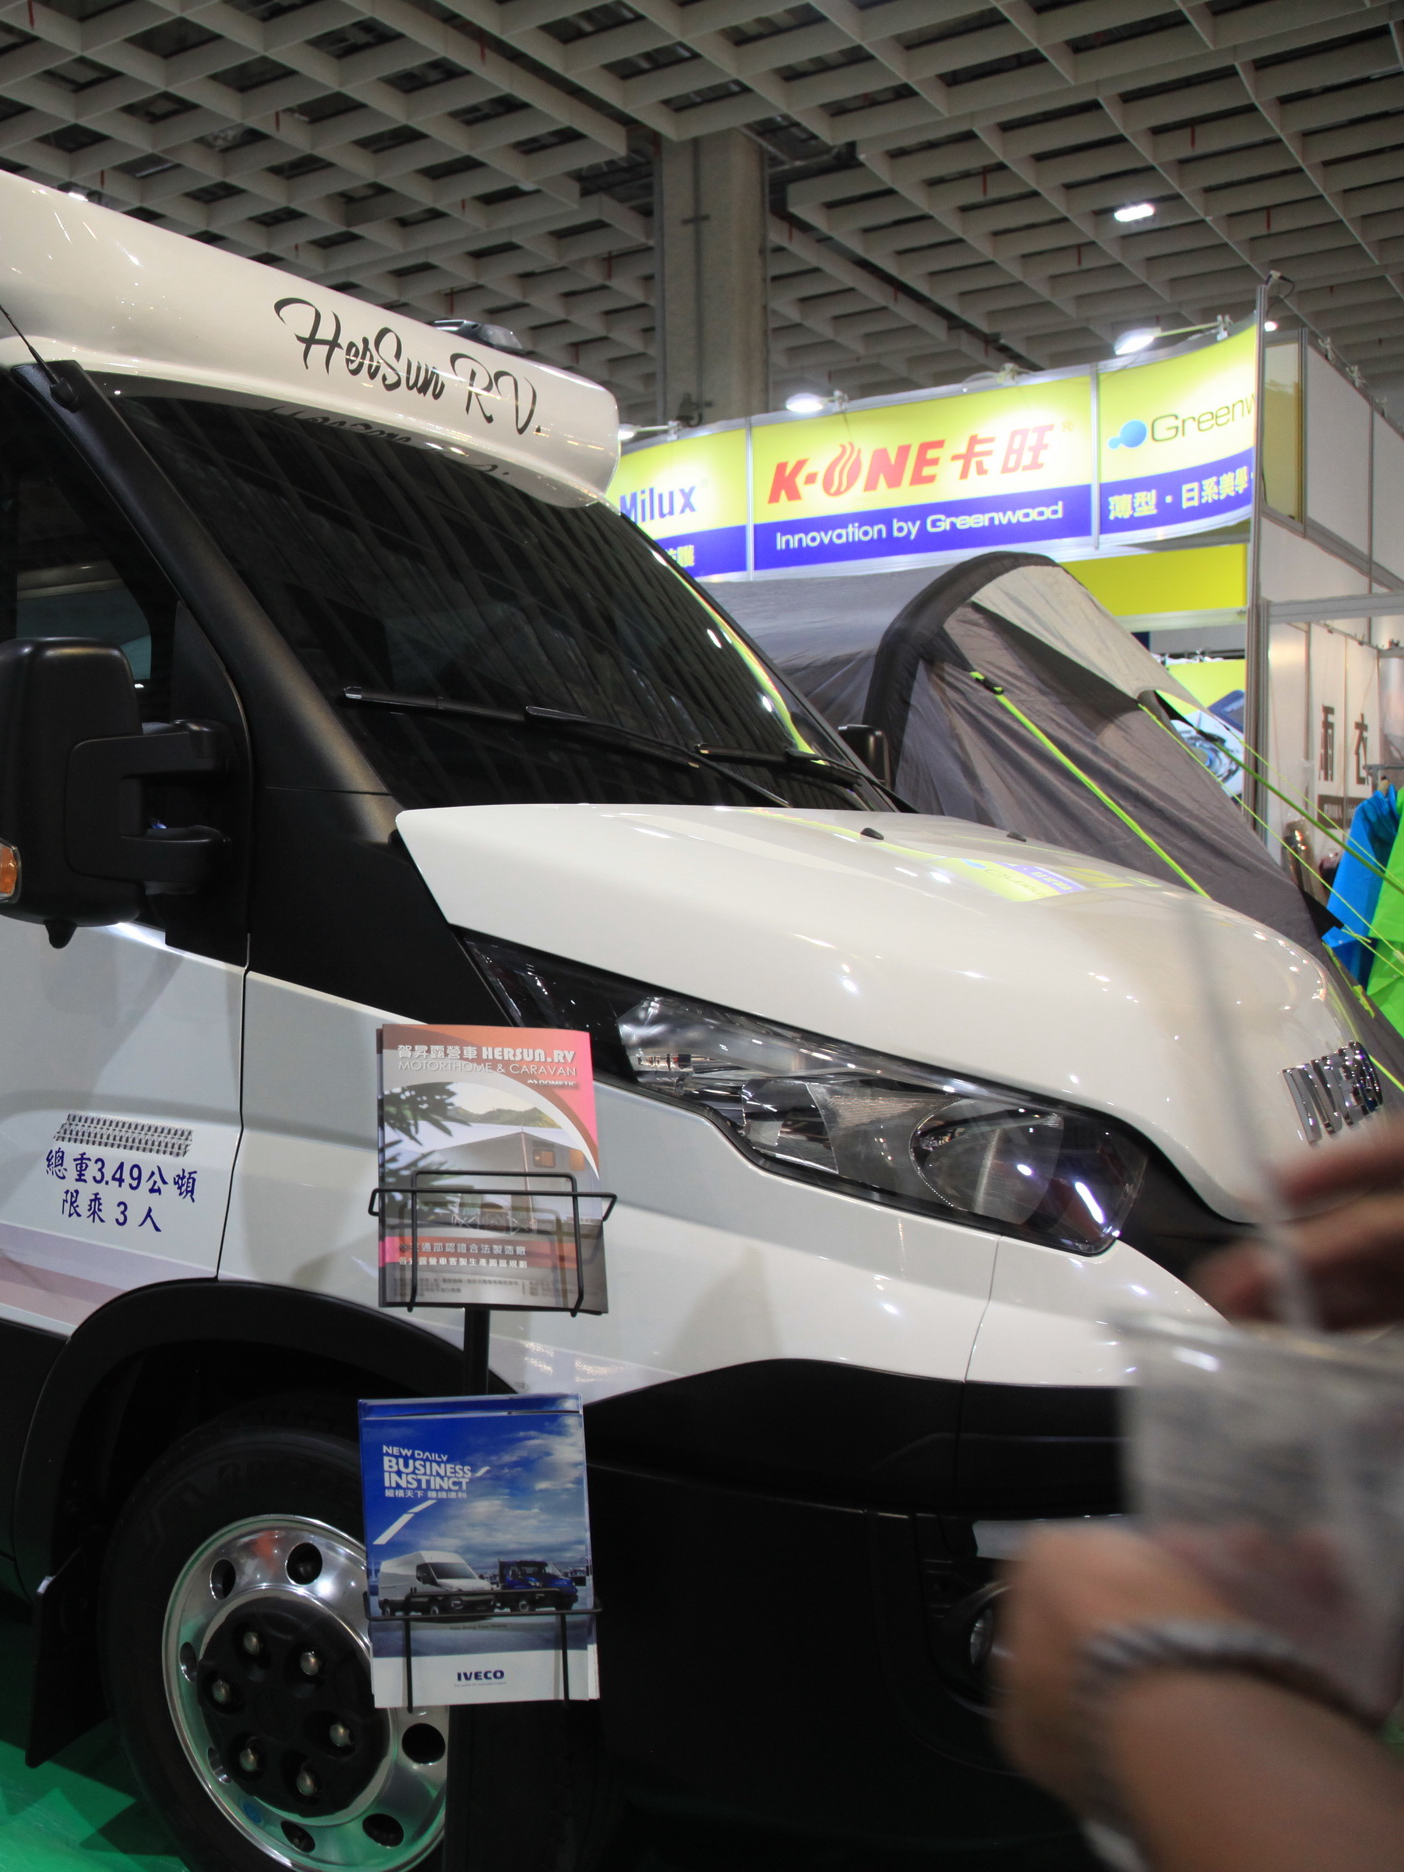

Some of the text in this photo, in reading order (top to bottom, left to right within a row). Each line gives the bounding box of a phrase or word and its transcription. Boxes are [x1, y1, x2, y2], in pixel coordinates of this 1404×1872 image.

[273, 297, 446, 400] HerSun
[950, 424, 1055, 480] 卡旺
[619, 486, 696, 524] Milux
[776, 500, 1064, 551] Innovation by Greenwood
[497, 1064, 506, 1074] &
[510, 1063, 577, 1077] CARAVAN
[382, 1445, 448, 1461] NEW DAILY
[383, 1456, 472, 1478] BUSINESS
[384, 1472, 470, 1491] INSTINCT
[457, 1670, 505, 1682] IVECO
